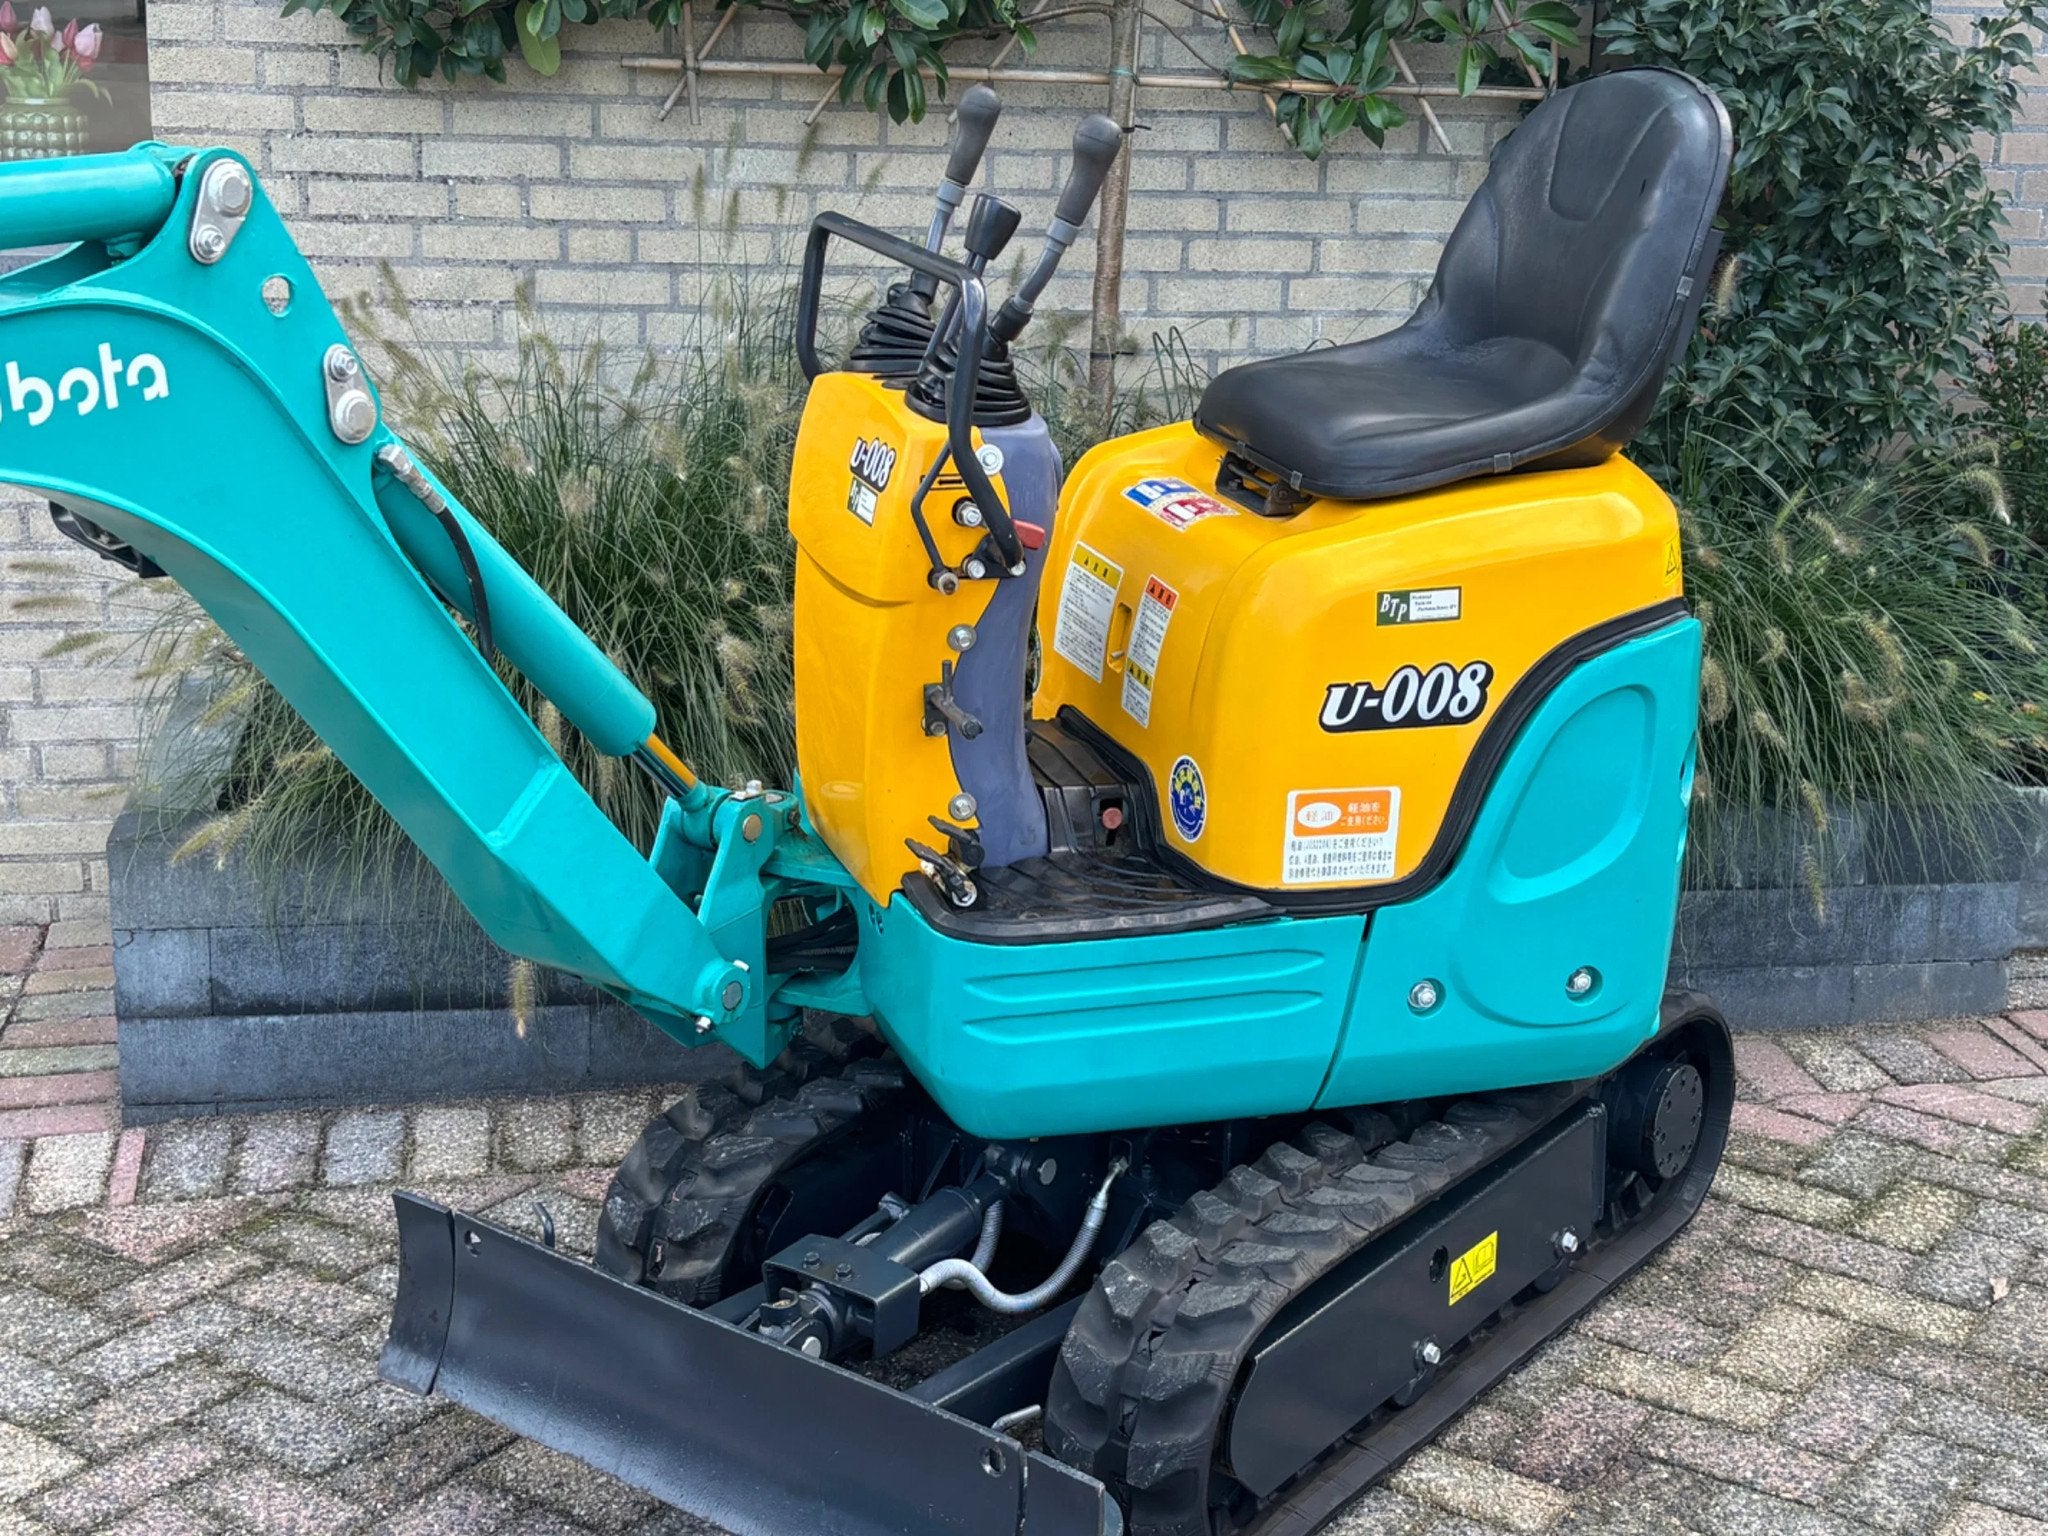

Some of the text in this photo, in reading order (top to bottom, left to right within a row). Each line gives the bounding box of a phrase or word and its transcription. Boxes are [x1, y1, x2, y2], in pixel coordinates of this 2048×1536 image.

[0, 342, 169, 426] bota
[851, 438, 895, 487] U-008
[1380, 593, 1408, 622] BTP
[1321, 662, 1487, 726] U-008
